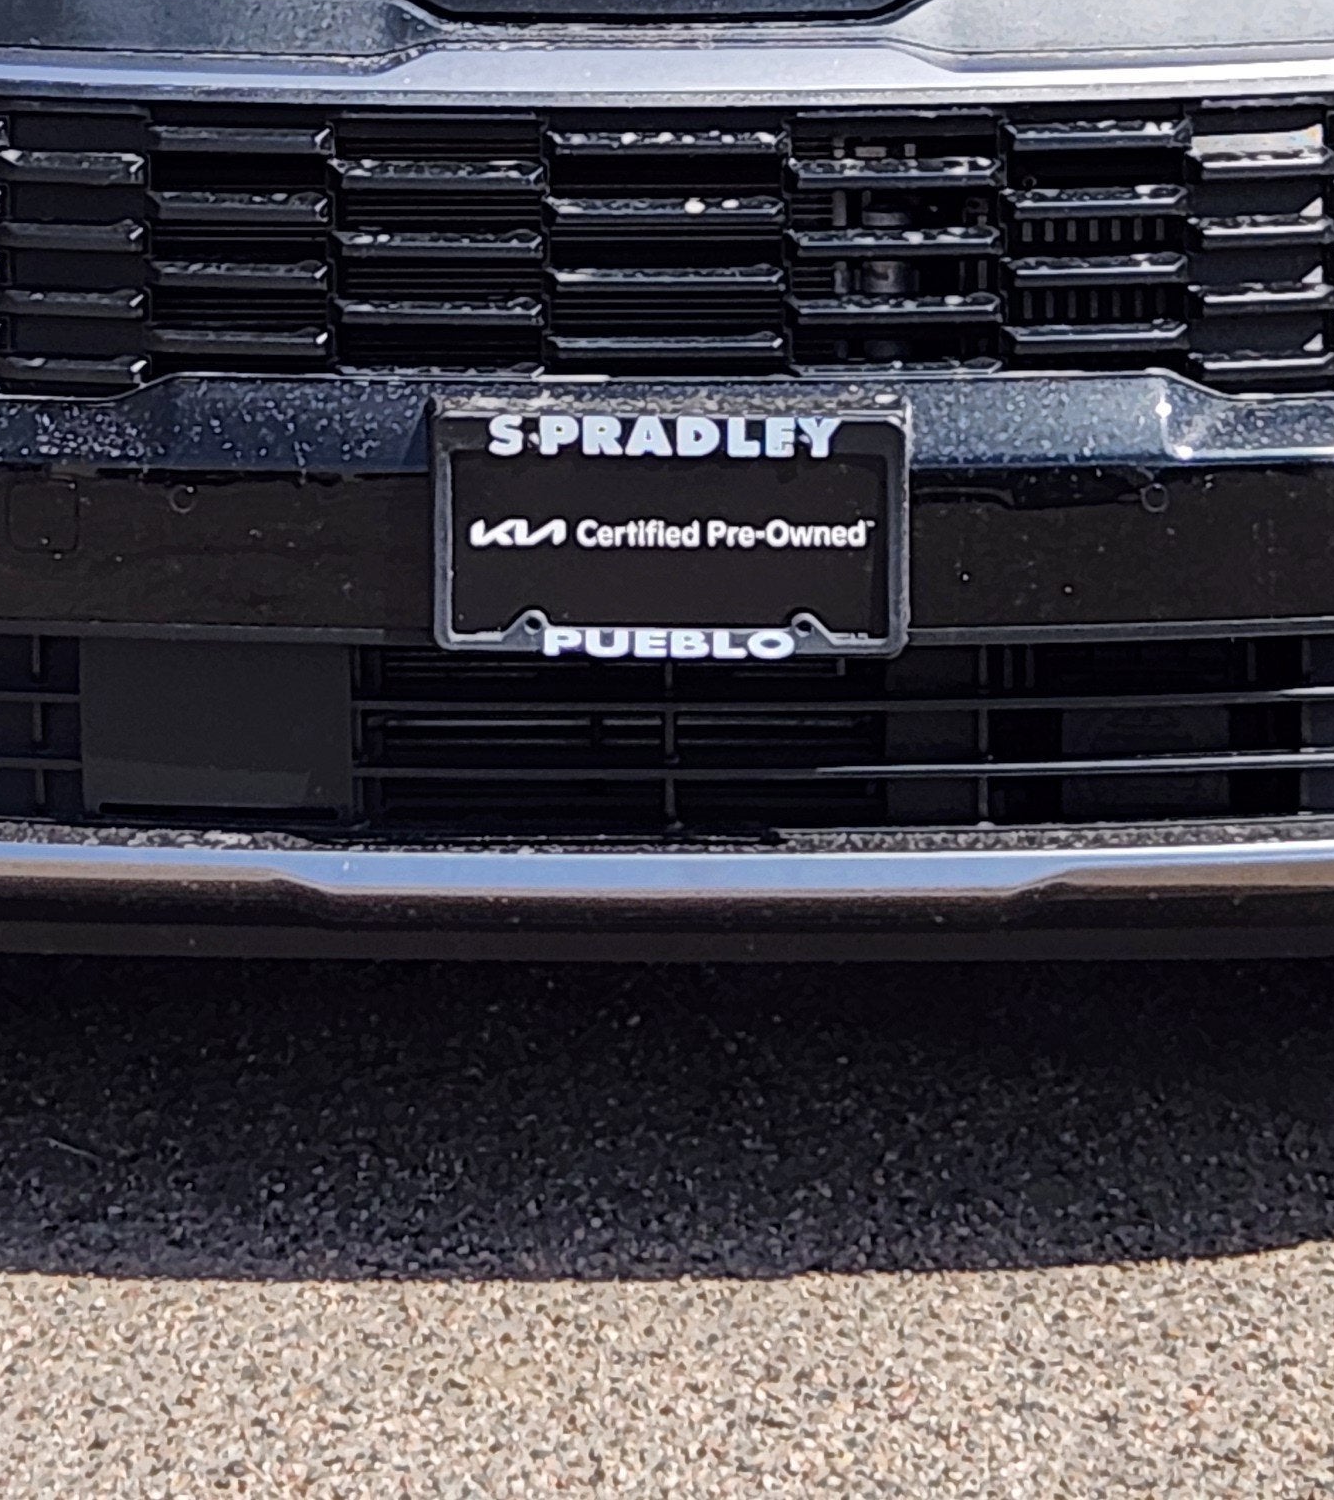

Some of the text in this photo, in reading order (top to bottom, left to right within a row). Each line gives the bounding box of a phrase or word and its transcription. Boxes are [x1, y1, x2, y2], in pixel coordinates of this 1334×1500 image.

[488, 414, 842, 457] SPRADLEY
[470, 518, 867, 548] KIA Certified Pre-Owned
[543, 628, 795, 659] PUEBLO
